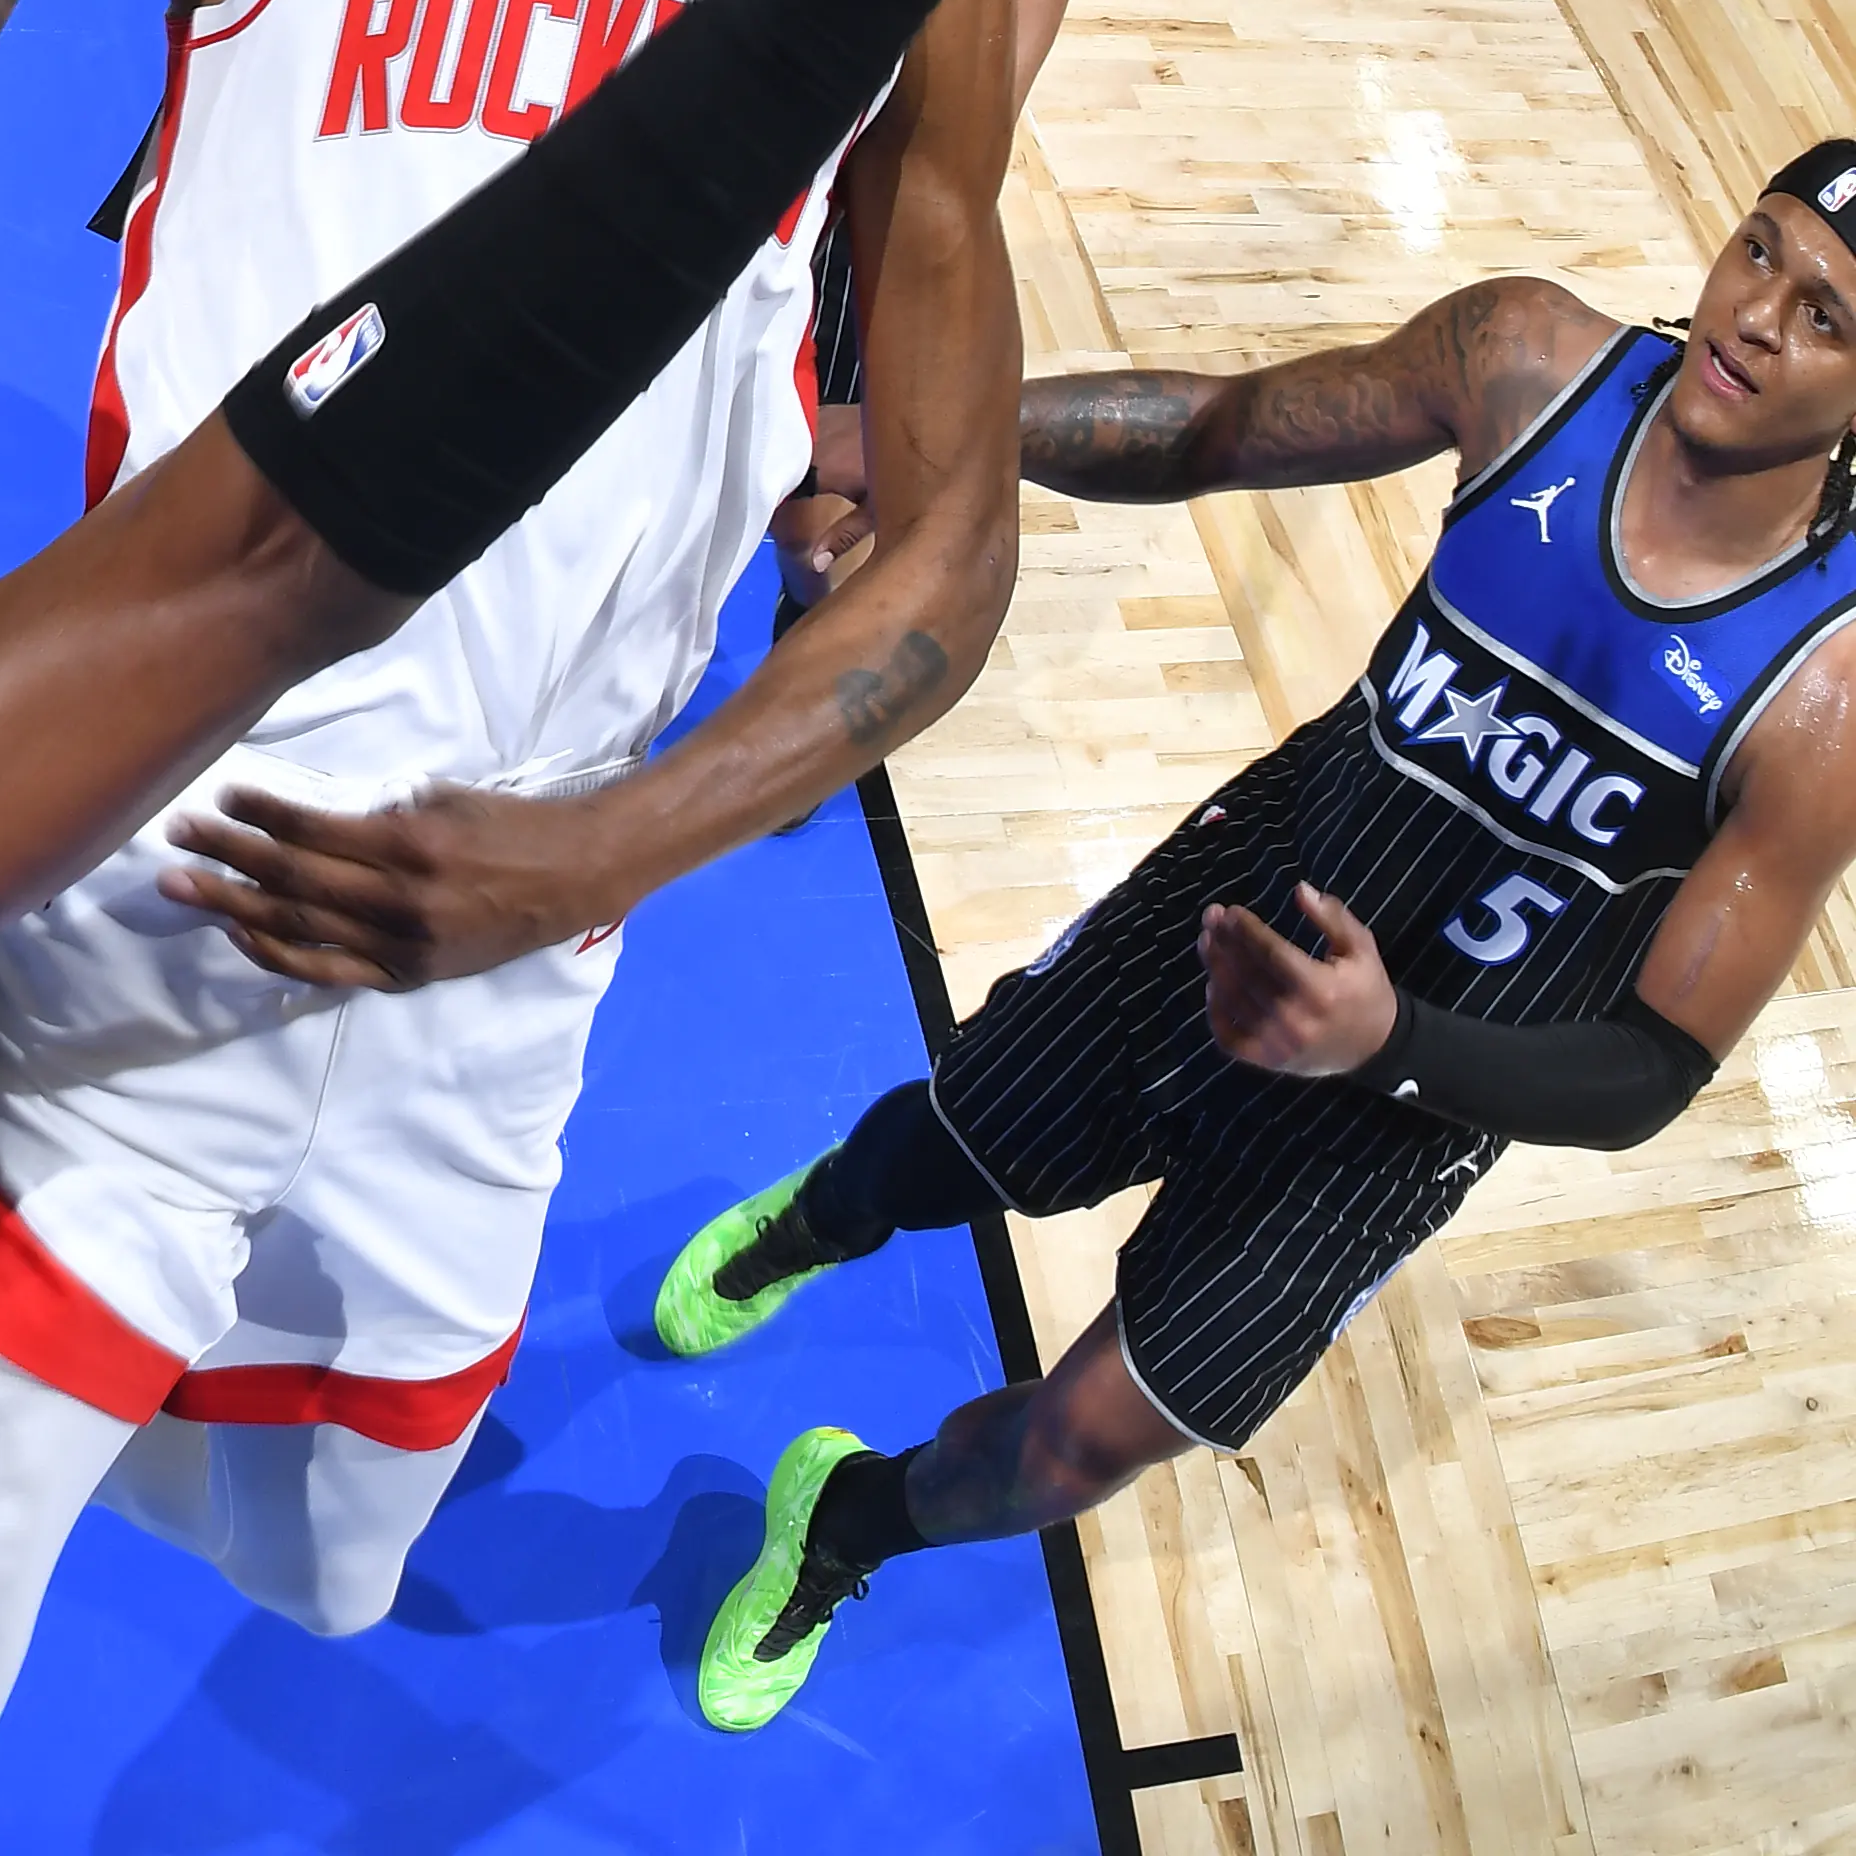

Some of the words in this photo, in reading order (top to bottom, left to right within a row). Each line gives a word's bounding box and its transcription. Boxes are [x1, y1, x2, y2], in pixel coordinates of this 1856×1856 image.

[1664, 634, 1723, 714] Disney
[1385, 620, 1648, 847] MAGIC
[1442, 871, 1570, 965] 5
